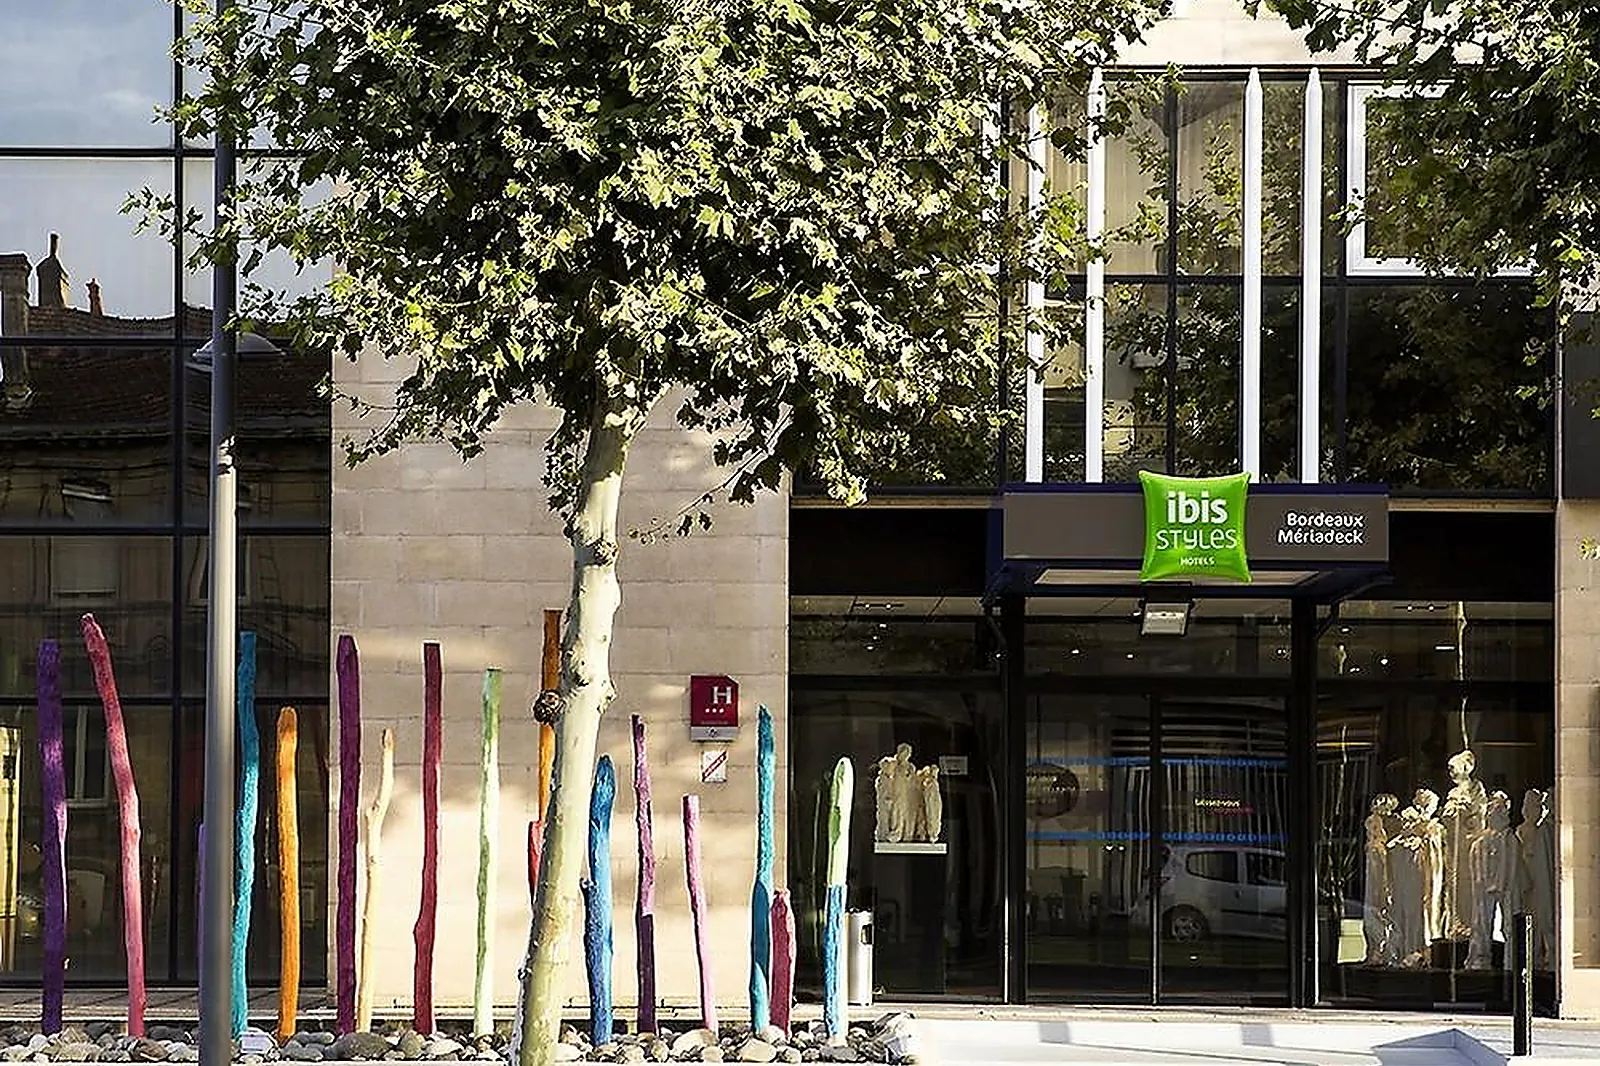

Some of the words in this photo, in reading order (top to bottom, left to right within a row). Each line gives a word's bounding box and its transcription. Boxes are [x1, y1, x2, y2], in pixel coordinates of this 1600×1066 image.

[1167, 491, 1228, 523] ibis
[1287, 512, 1364, 527] Bordeaux
[1156, 529, 1237, 549] STYLES
[1278, 528, 1363, 543] Mériadeck
[1180, 557, 1215, 566] HOTELS
[713, 686, 732, 704] H
